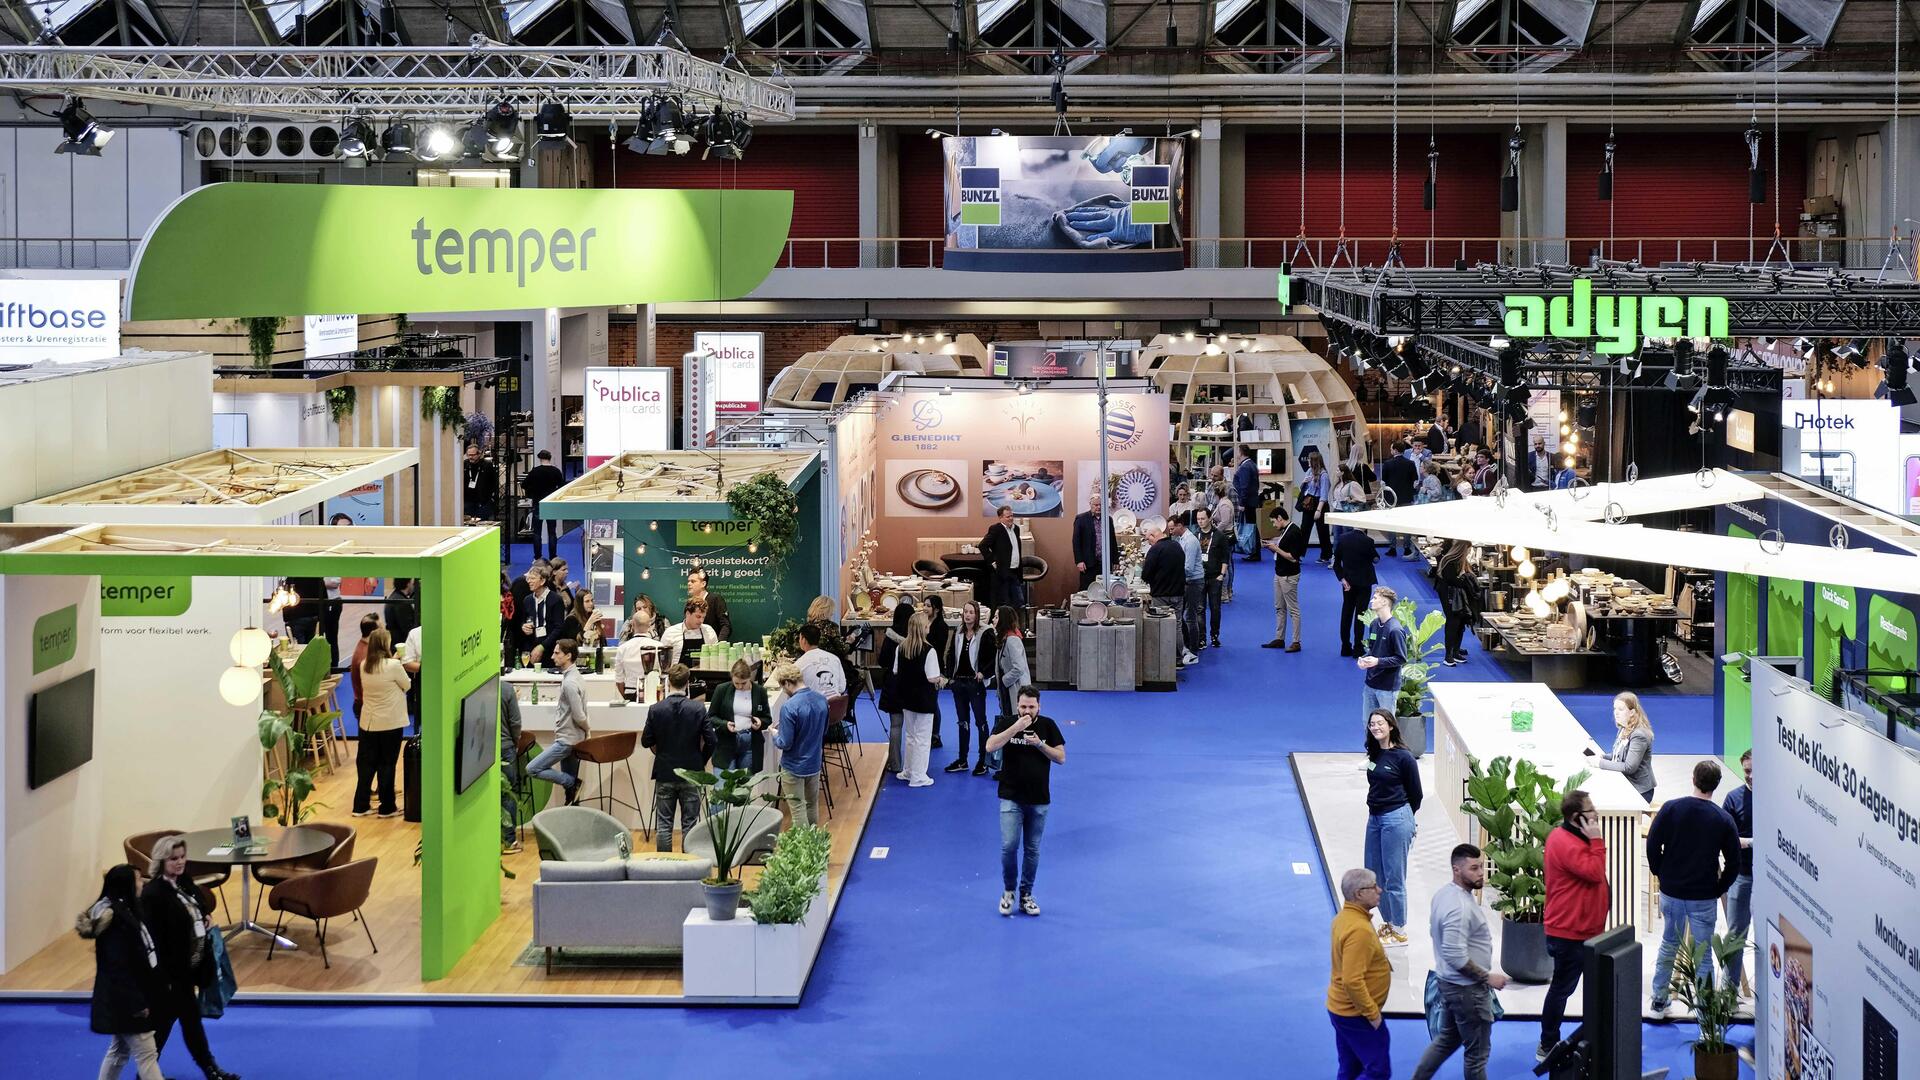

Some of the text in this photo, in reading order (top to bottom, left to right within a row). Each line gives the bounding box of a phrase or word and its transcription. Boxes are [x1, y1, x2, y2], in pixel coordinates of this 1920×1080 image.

[961, 190, 1000, 203] BUNZL
[1131, 188, 1169, 201] BUNZL
[411, 217, 597, 288] temper
[0, 302, 106, 329] iftbase
[1504, 279, 1729, 355] adyen
[27, 335, 33, 343] &
[36, 335, 107, 345] Urenregistratie
[600, 386, 661, 402] Publica
[1801, 413, 1855, 430] Hotek
[891, 434, 962, 442] G.BENEDIKT
[915, 443, 938, 451] 1882
[690, 520, 754, 535] temper
[671, 556, 770, 565] Personeelstekort?
[706, 567, 764, 578] zit je goed.
[101, 584, 175, 603] temper
[1822, 586, 1850, 610] Quick Service
[1879, 615, 1908, 641] Restaurants
[39, 626, 72, 653] temper
[461, 628, 483, 657] temper
[1776, 715, 1920, 845] Test de Kiosk 30 dagen gra
[1777, 828, 1819, 882] Bestel online
[1875, 913, 1920, 973] Monitor all
